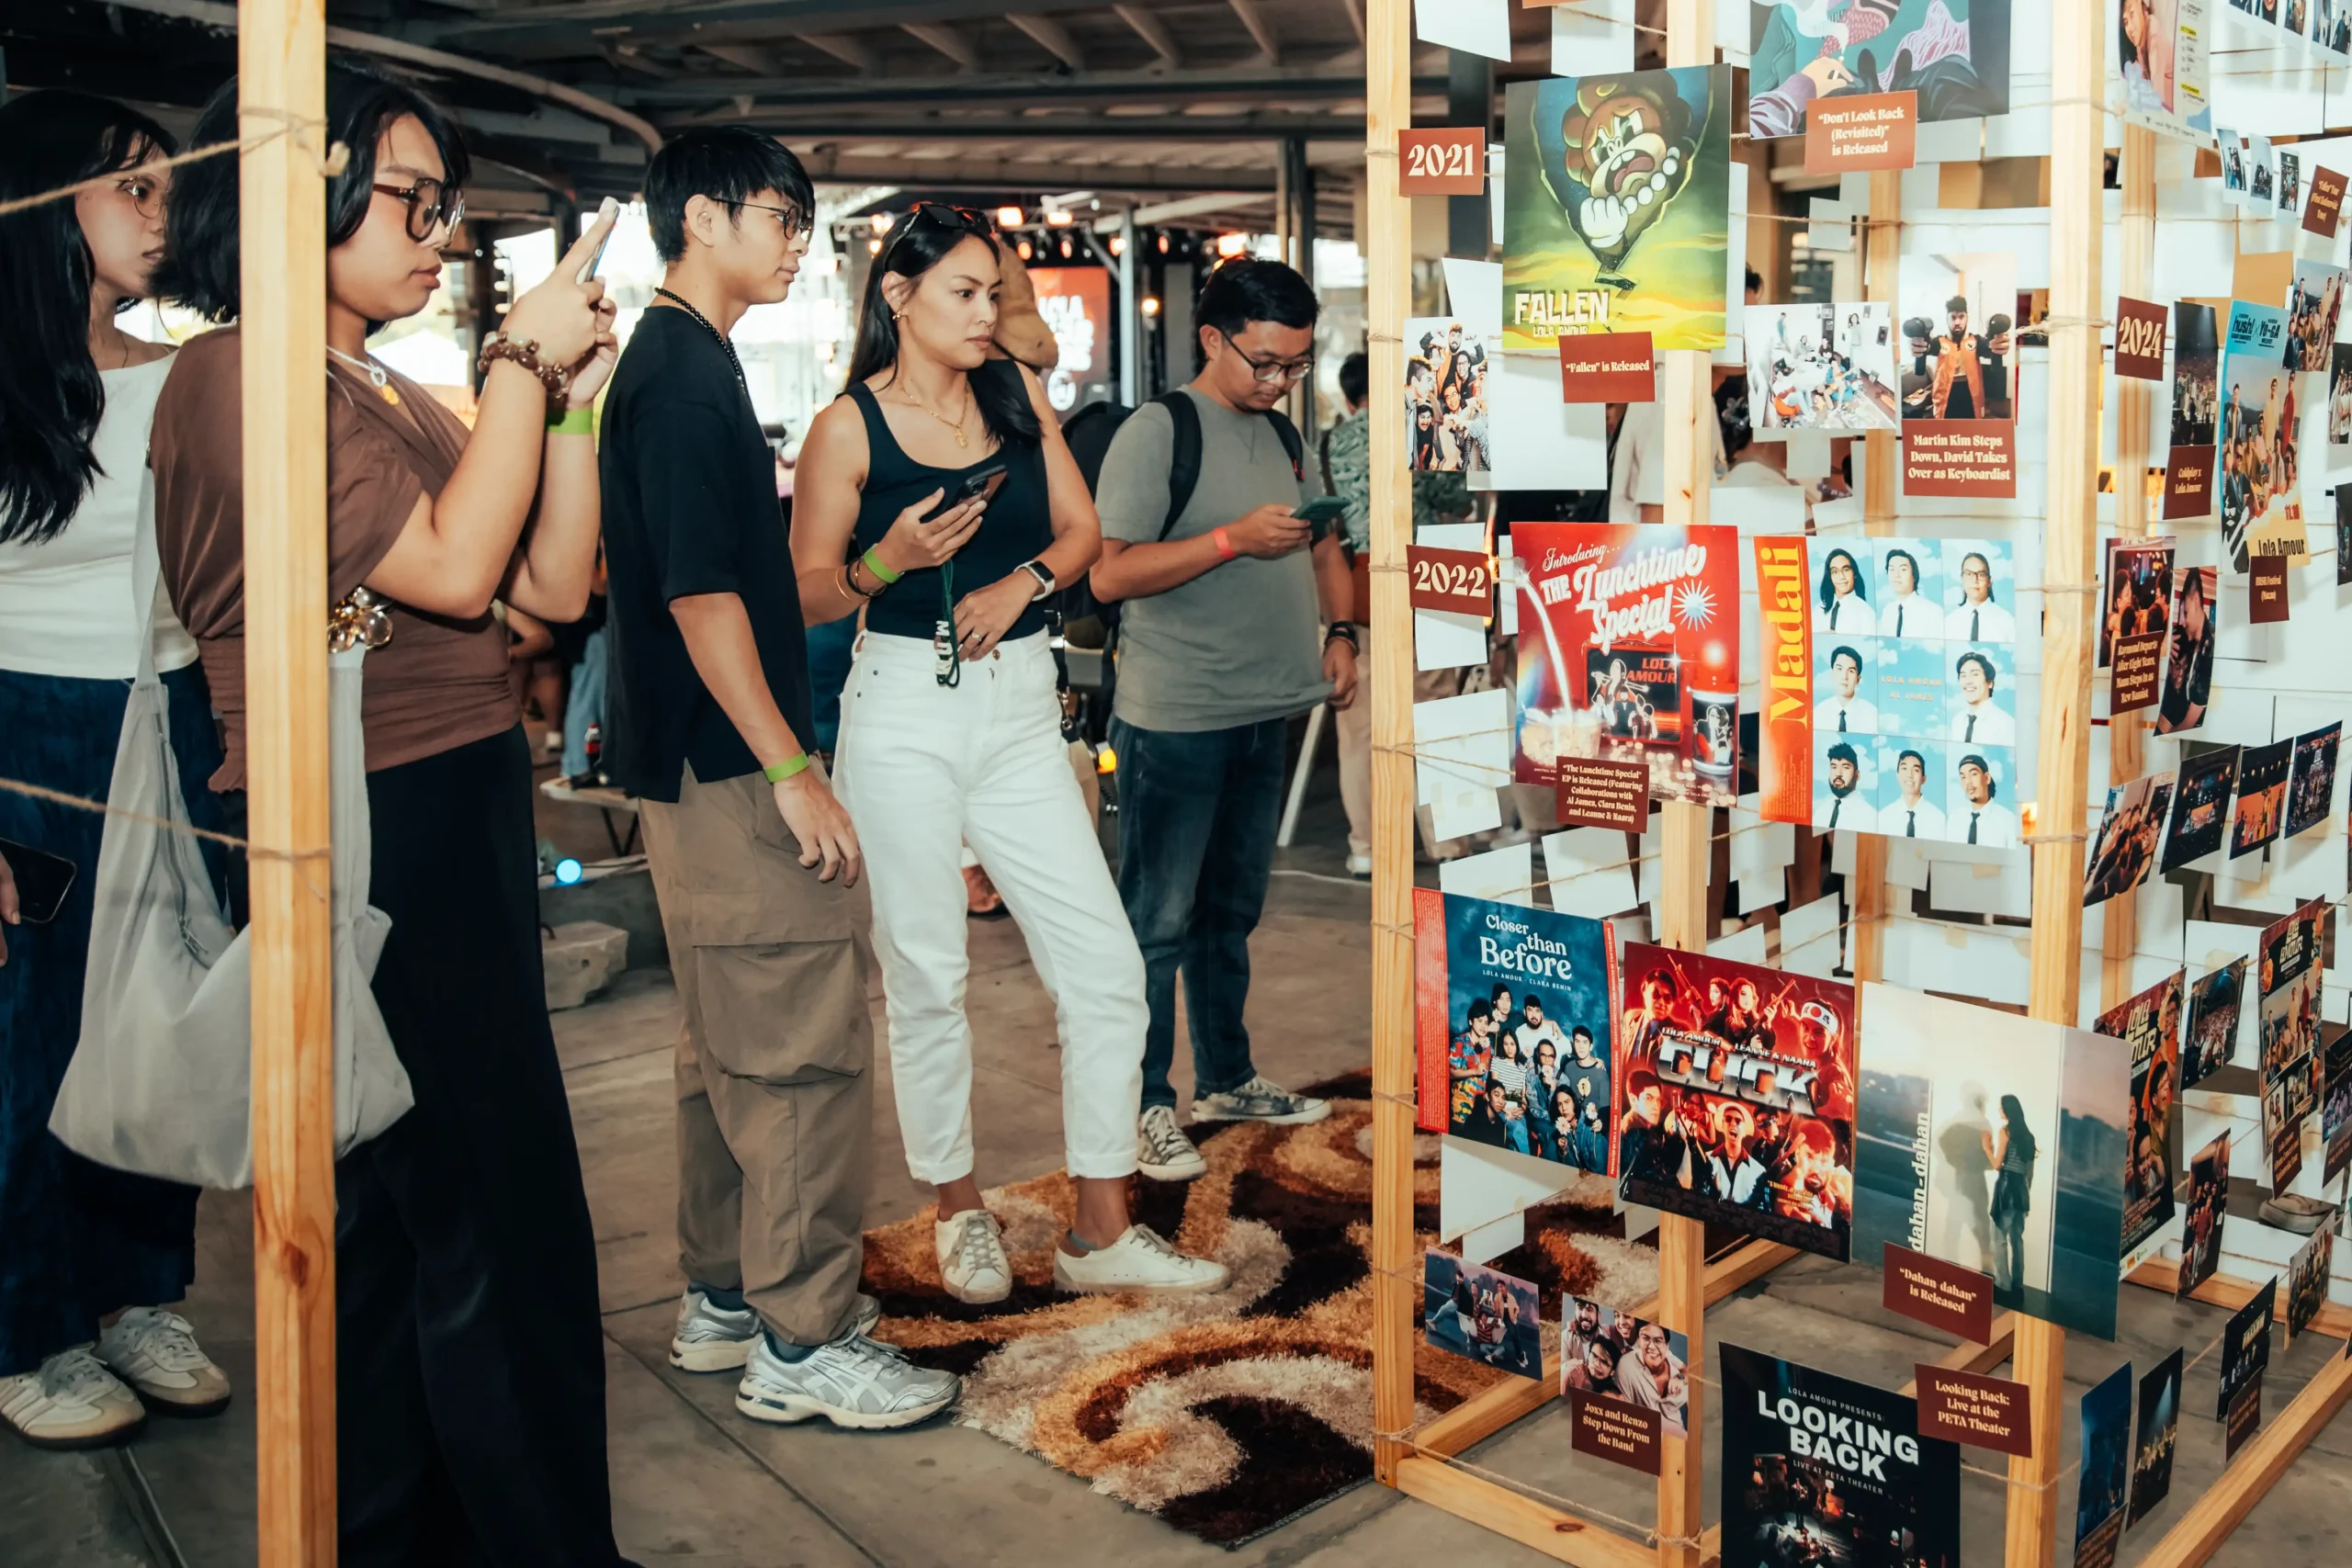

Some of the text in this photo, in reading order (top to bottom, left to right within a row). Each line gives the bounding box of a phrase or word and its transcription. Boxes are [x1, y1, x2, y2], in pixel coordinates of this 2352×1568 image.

[1818, 107, 1904, 124] "Don't Look Back
[1831, 125, 1890, 141] (Revisited)"
[1407, 143, 1474, 177] 2021
[1832, 141, 1888, 156] is Released
[1514, 290, 1610, 325] FALLEN
[1533, 325, 1555, 337] LOLA
[2118, 316, 2163, 358] 2024
[1566, 359, 1650, 373] "Fallen" is Released
[1914, 434, 2003, 449] Martin Kim Steps
[1910, 451, 2007, 463] Down, David Takes
[1908, 468, 2010, 482] Over as Keyboardist
[2258, 537, 2305, 556] Lola Amour
[1413, 560, 1487, 598] 2022
[1539, 543, 1707, 614] THE Lunchtime
[1590, 584, 1676, 657] Special
[1760, 544, 1807, 729] Madali
[1626, 658, 1677, 682] LOLA AMOUR
[1881, 675, 1941, 686] LOLA AMOUR
[1563, 764, 1578, 773] "The
[1580, 765, 1614, 776] Lunchtime
[1615, 769, 1642, 779] Special"
[1562, 774, 1571, 783] EP
[1572, 775, 1578, 784] is
[1579, 776, 1608, 786] Released
[1609, 779, 1643, 793] (Featuring
[1571, 786, 1633, 800] Collaborations with
[1566, 796, 1637, 812] Al James, Clara Benin,
[1568, 808, 1634, 824] and Leanne & Naara)
[1486, 914, 1529, 935] Closer
[1526, 932, 1567, 955] than
[1479, 936, 1572, 980] Before
[1482, 969, 1572, 992] LOLA AMOUR CLARA BENIN
[2125, 998, 2151, 1042] LOLA
[1662, 1027, 1817, 1068] LOLA AMOUR LEANNE & NAARA
[1656, 1038, 1817, 1117] CLICK
[1907, 1112, 1929, 1253] dahan-dahan
[1909, 1284, 1965, 1314] is Released
[1788, 1386, 1807, 1398] LOLA
[1810, 1393, 1838, 1407] AMOUR
[1935, 1380, 2010, 1405] Looking Back:
[1584, 1403, 1648, 1429] Joxx and Renzo
[1947, 1397, 2000, 1419] Live at the
[1583, 1416, 1650, 1444] Step Down From
[1758, 1389, 1919, 1466] LOOKING
[1938, 1411, 2010, 1437] PETA Theater
[1598, 1433, 1634, 1452] the Band
[1790, 1426, 1886, 1483] BACK
[1792, 1460, 1883, 1495] LIVE AT PETA THEATER
